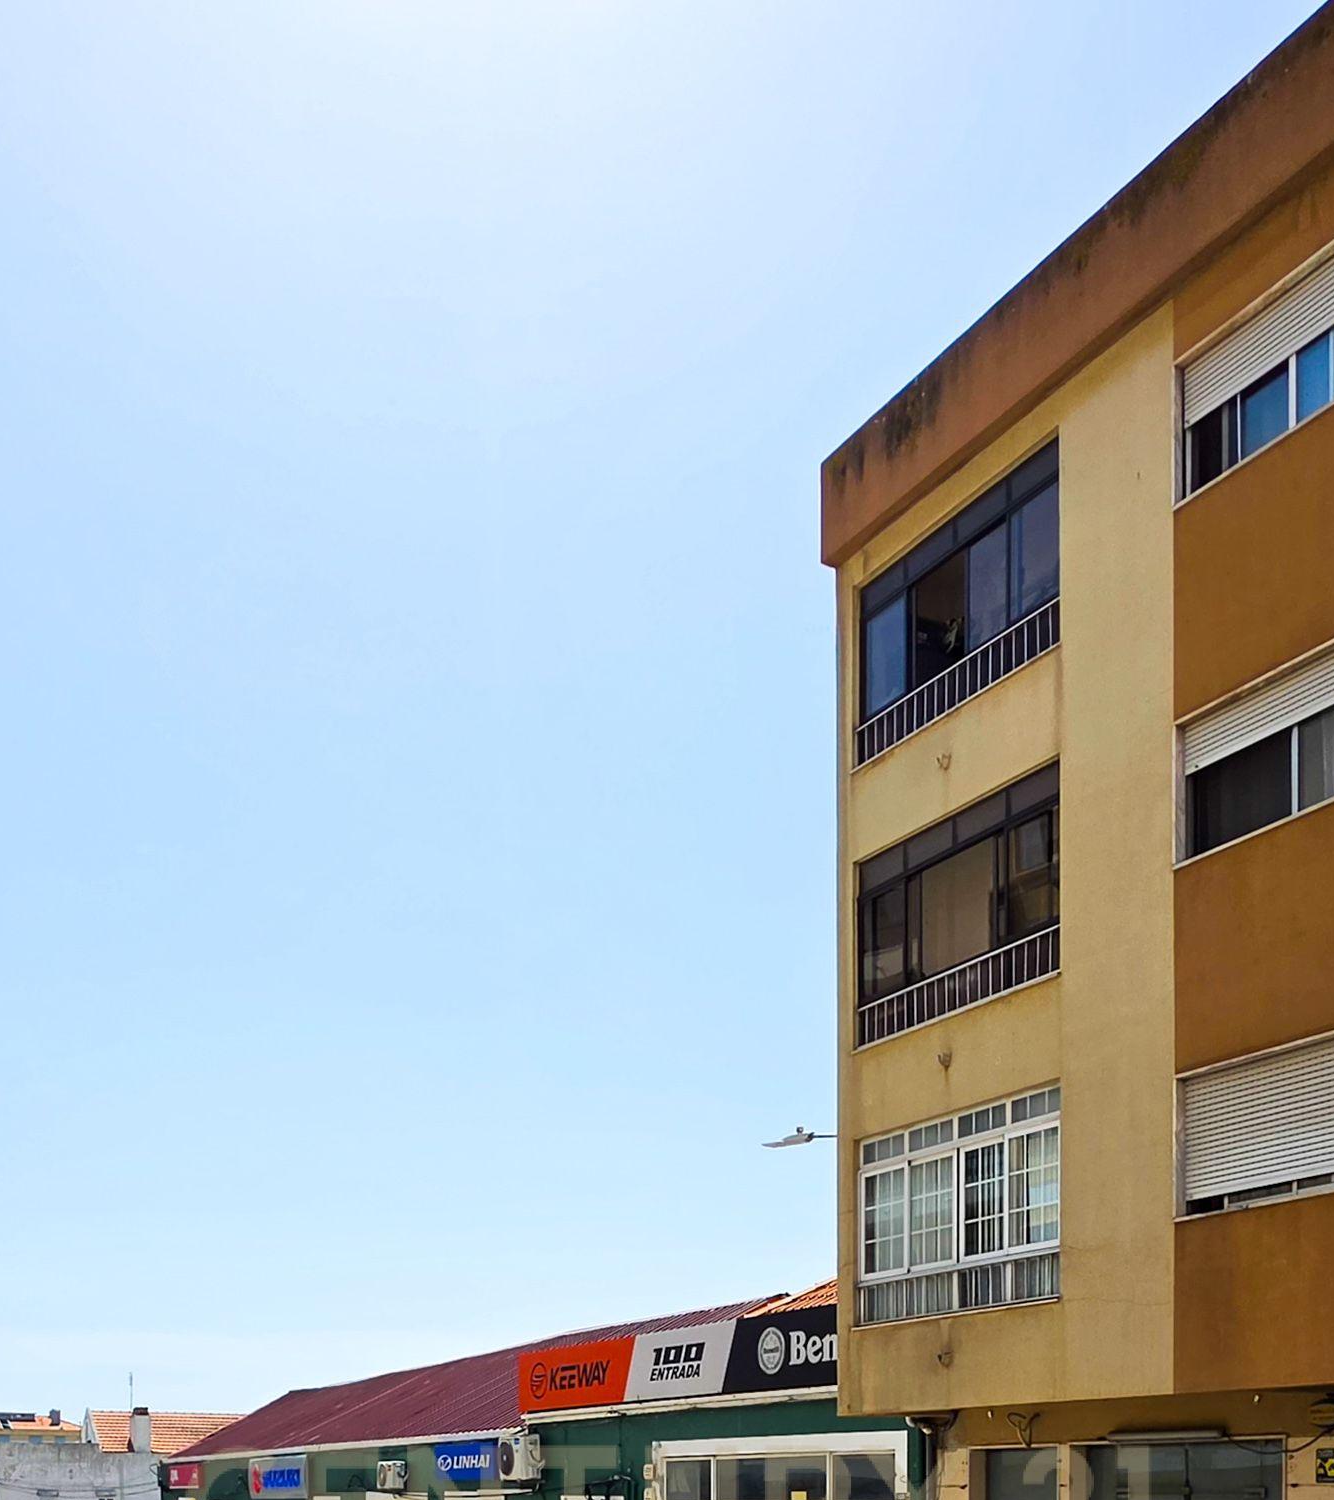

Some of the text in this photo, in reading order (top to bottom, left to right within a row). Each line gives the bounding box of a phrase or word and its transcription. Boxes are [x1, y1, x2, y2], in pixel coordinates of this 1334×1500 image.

[652, 1342, 706, 1367] 100
[788, 1330, 838, 1366] Ben
[549, 1360, 611, 1392] KEEWAY
[649, 1363, 701, 1383] ENTRADA
[452, 1454, 491, 1470] LINHAI
